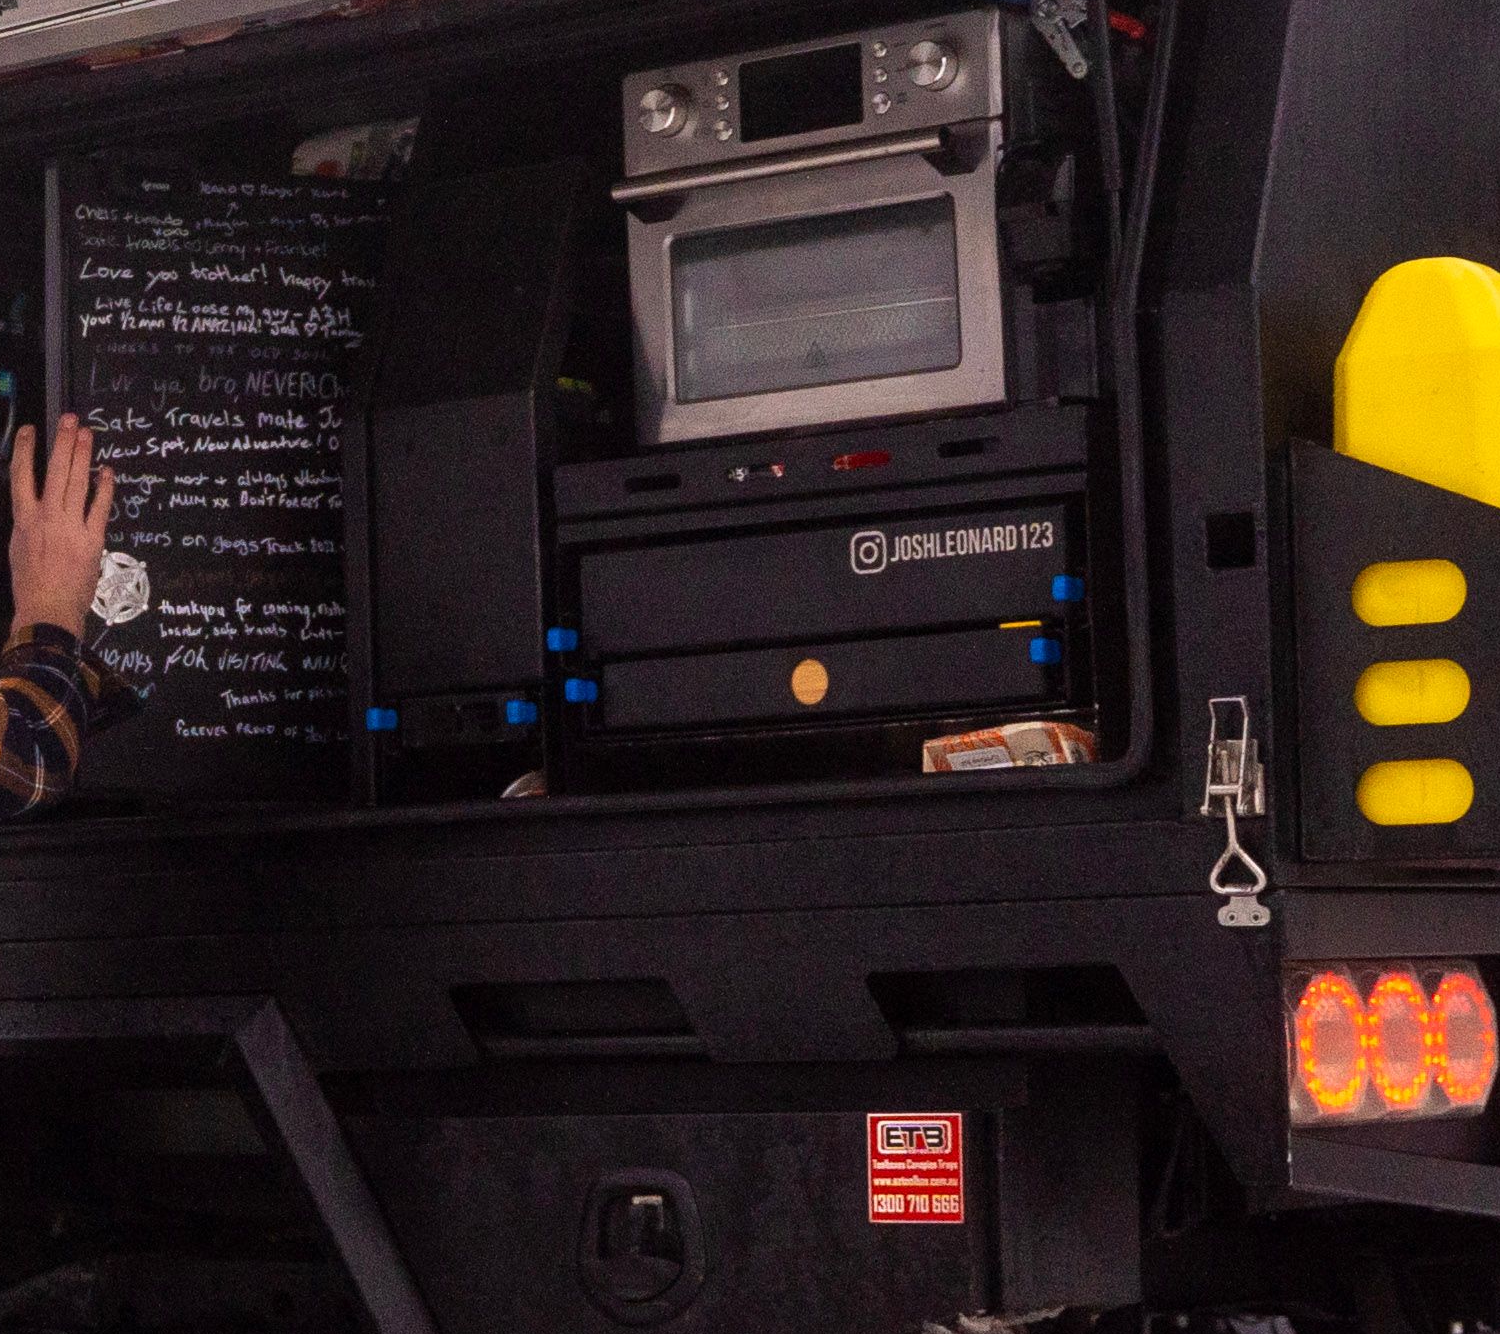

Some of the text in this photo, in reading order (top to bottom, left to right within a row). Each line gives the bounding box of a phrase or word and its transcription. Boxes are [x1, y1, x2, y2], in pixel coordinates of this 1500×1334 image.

[80, 256, 134, 280] Love
[165, 406, 246, 431] Travels
[96, 442, 141, 463] New
[192, 435, 230, 454] New
[891, 521, 1054, 563] JOSHLEONARD123
[220, 689, 276, 709] Thanks
[886, 1126, 944, 1148] ETB
[873, 1194, 960, 1213] 1300 710 666
